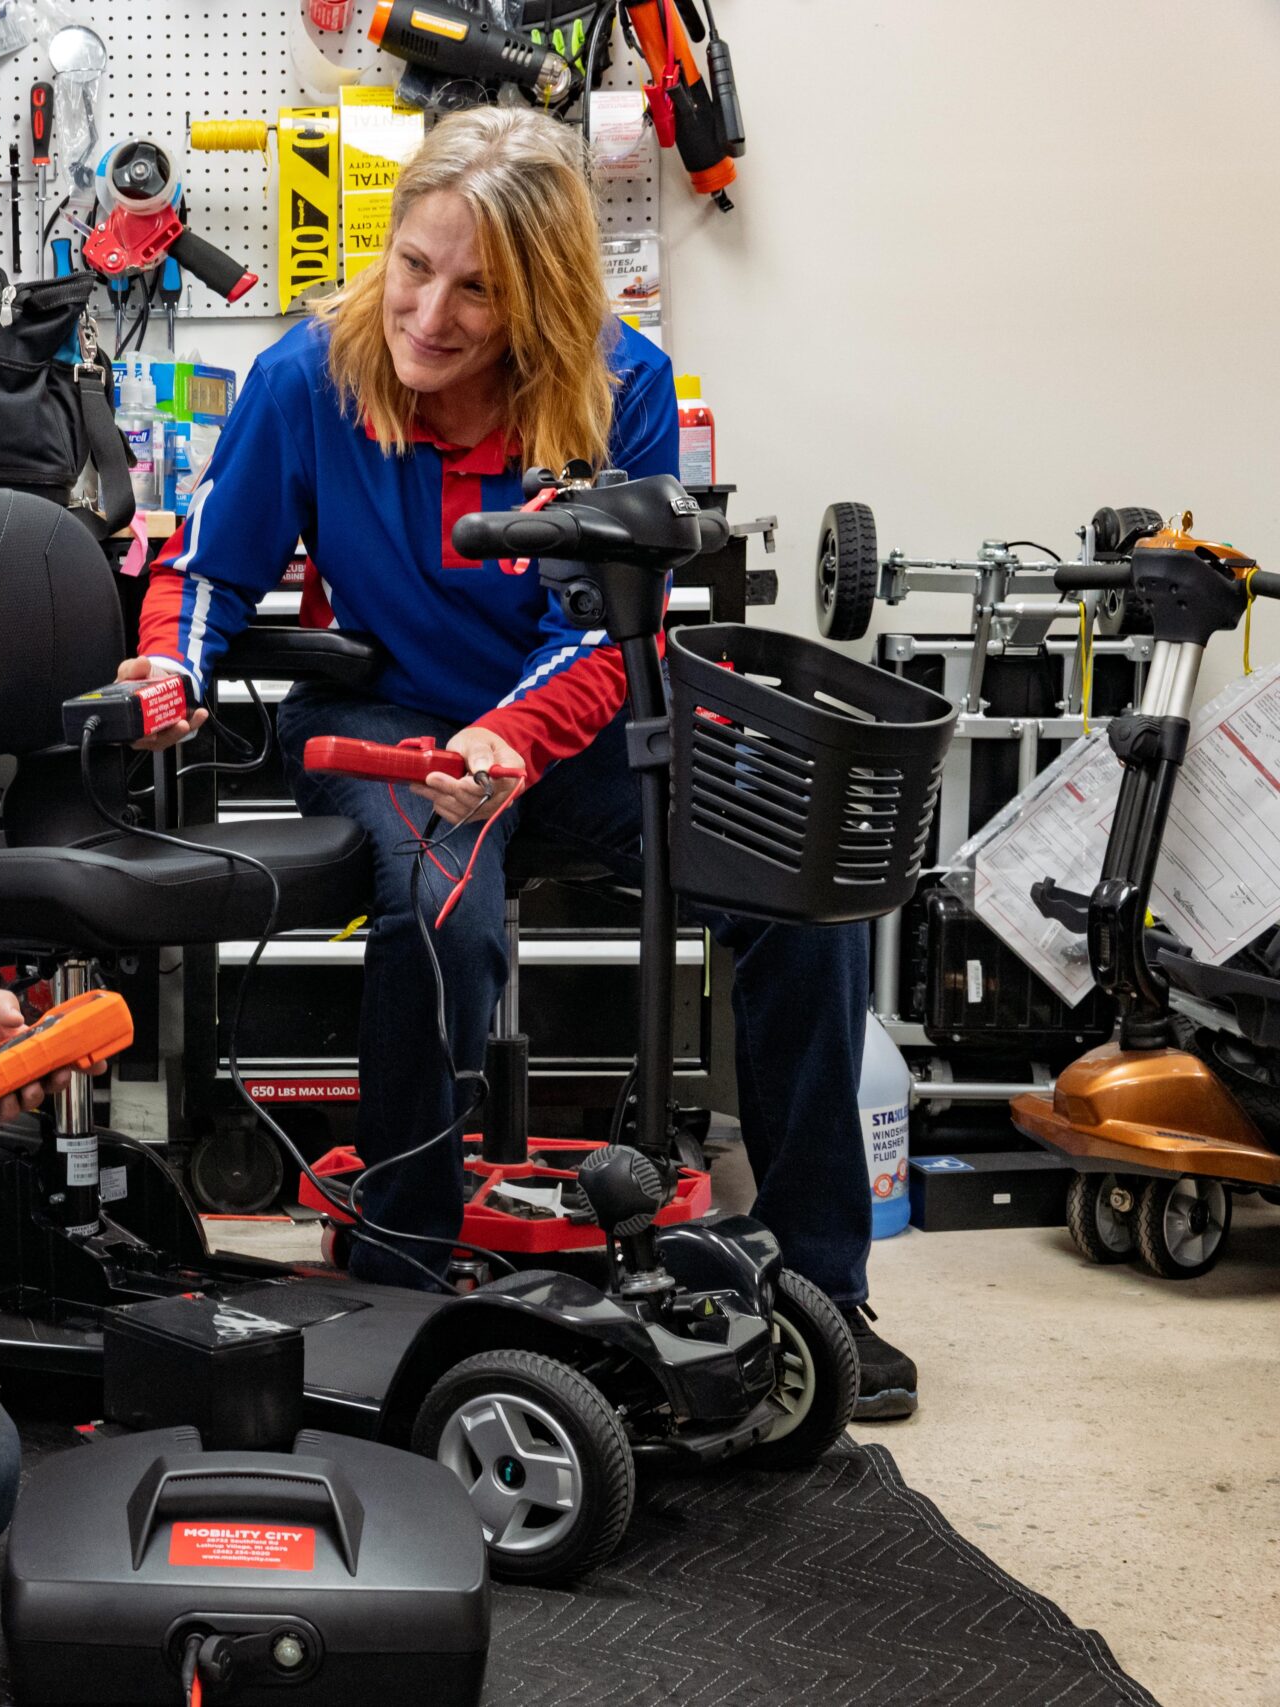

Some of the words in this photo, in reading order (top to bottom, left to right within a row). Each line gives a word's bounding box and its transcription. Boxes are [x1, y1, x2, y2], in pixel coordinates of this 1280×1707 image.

[349, 172, 396, 187] NTAL
[616, 265, 648, 274] BLADE
[139, 683, 168, 699] MOBILITY
[167, 677, 181, 692] CITY
[251, 1086, 275, 1097] 650
[277, 1087, 297, 1097] LBS
[298, 1086, 324, 1096] MAX
[326, 1086, 355, 1096] LOAD
[872, 1135, 905, 1152] WASHER
[873, 1149, 898, 1163] FLUID
[184, 1528, 261, 1540] MOBILITY
[265, 1531, 303, 1542] CITY
